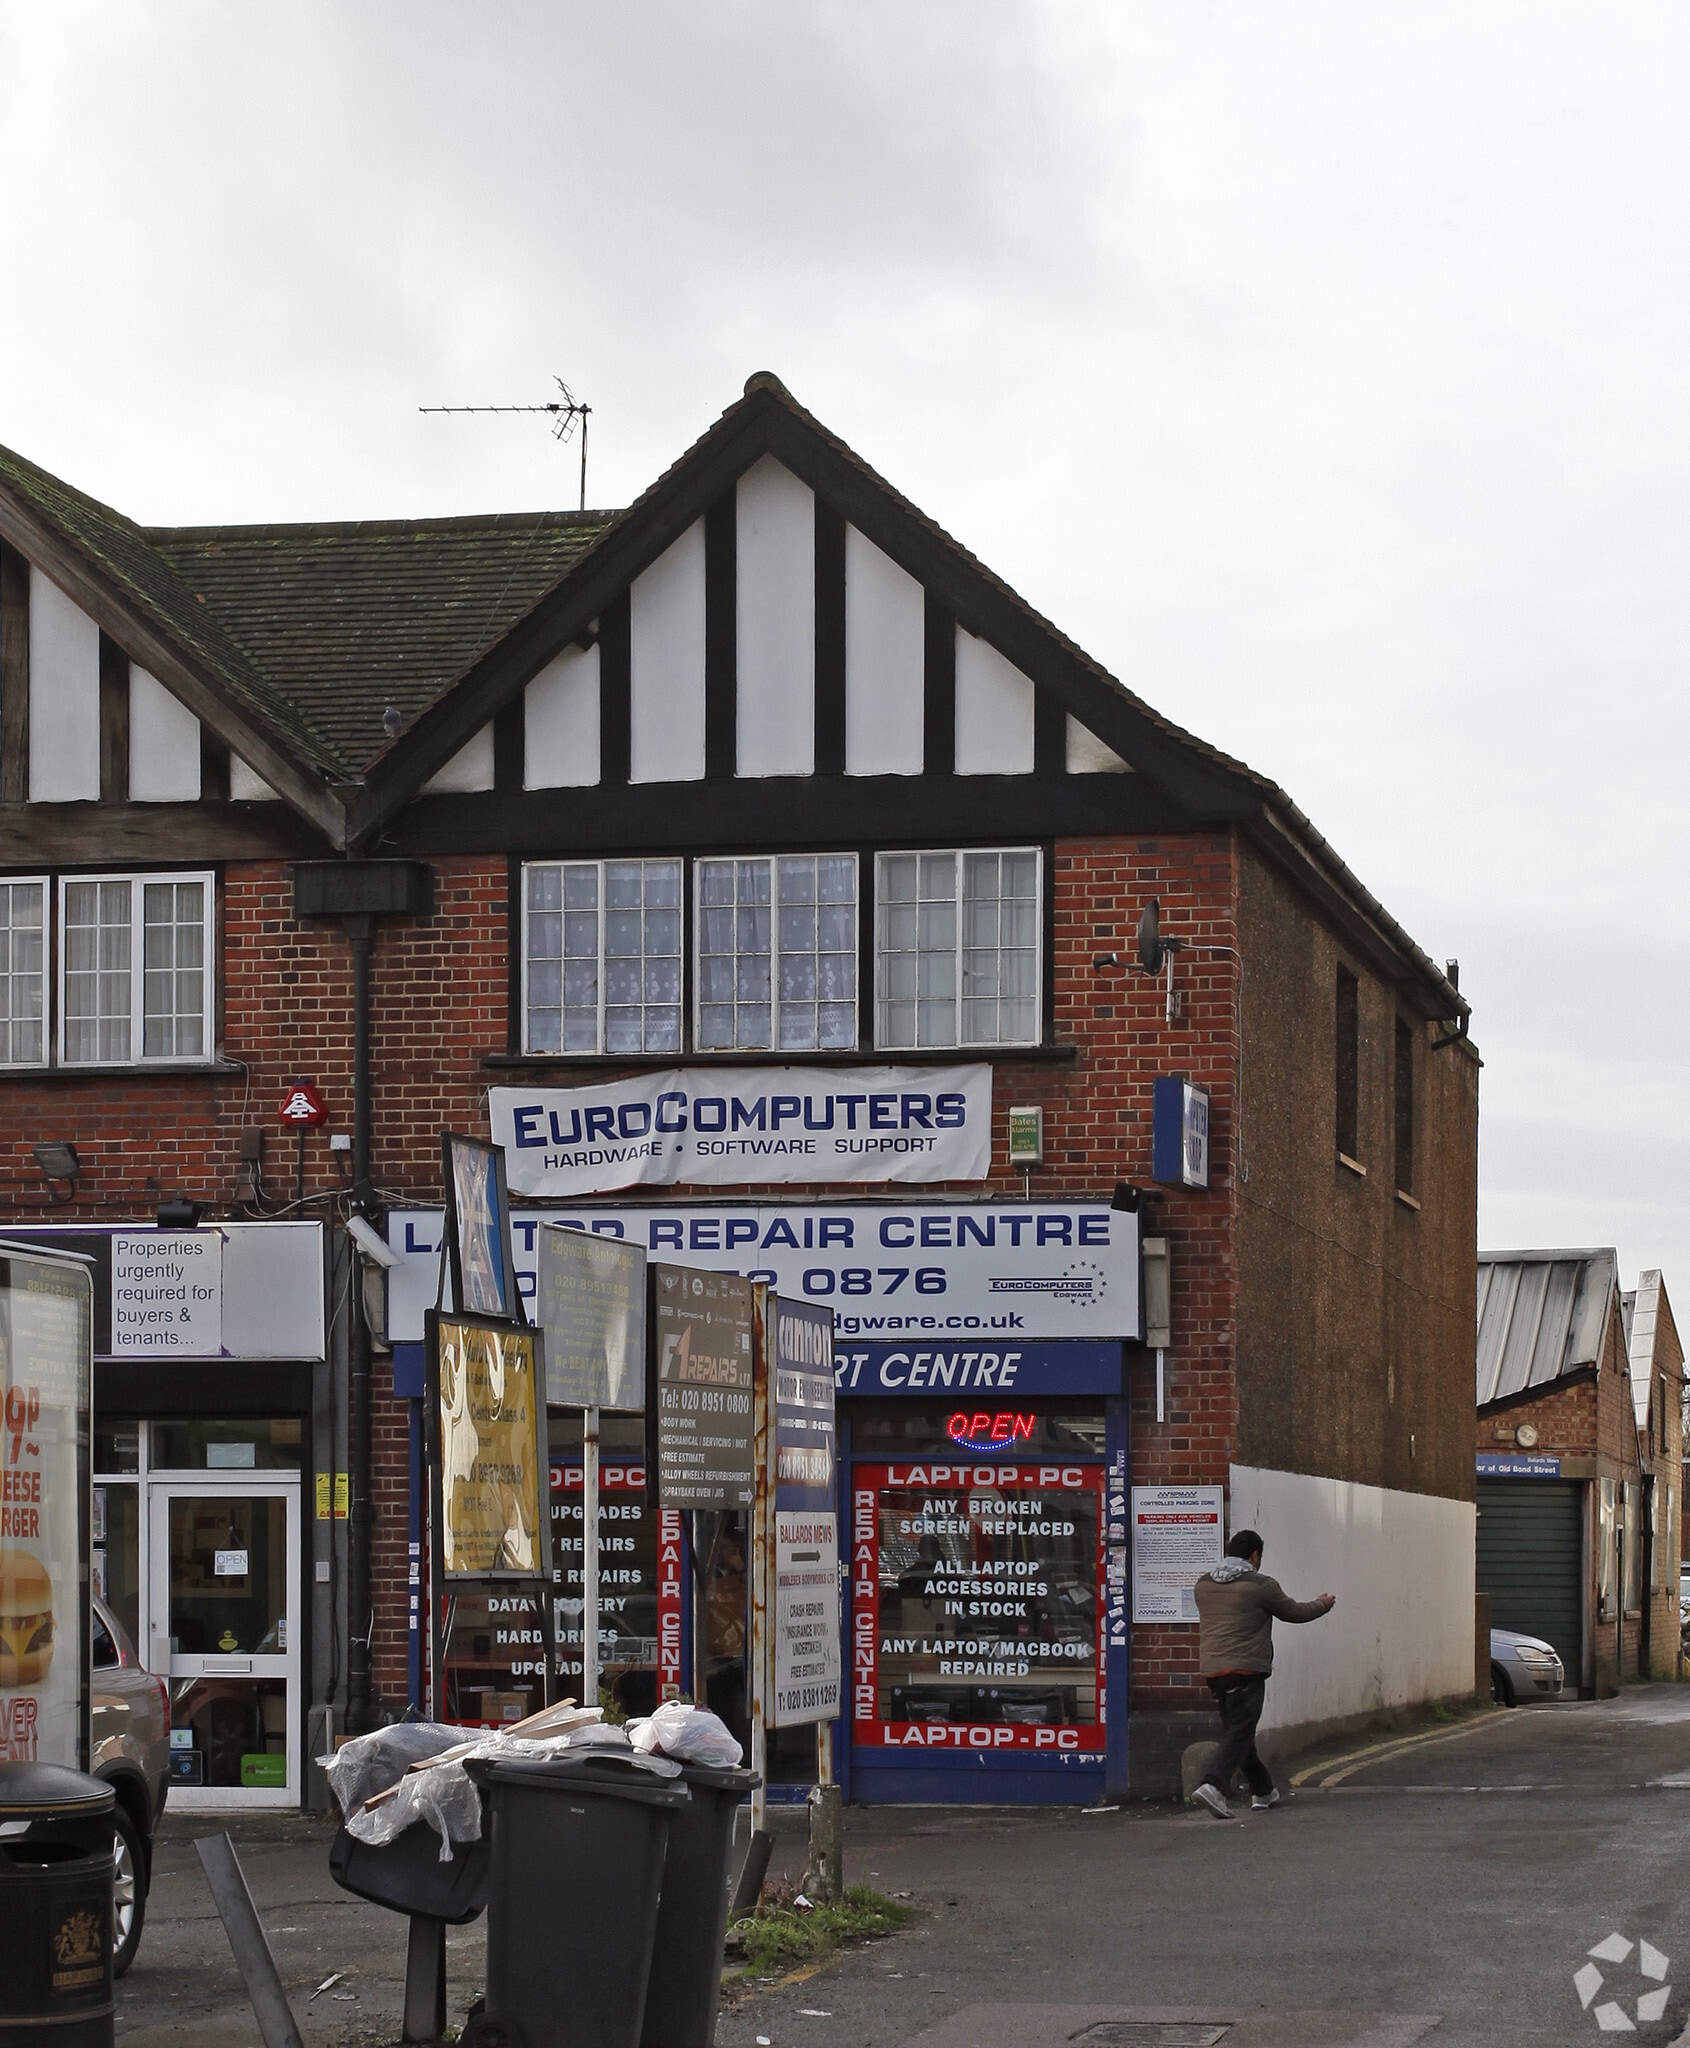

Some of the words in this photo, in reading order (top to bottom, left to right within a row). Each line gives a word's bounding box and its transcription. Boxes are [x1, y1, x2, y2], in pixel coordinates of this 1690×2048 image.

[544, 1141, 662, 1169] HARDWARE
[696, 1138, 816, 1156] SOFTWARE
[834, 1136, 937, 1154] SUPPORT
[649, 1217, 854, 1251] REPAIR
[879, 1214, 1110, 1249] CENTRE
[116, 1239, 204, 1258] Properties
[551, 1236, 592, 1261] Edgware
[116, 1262, 184, 1282] urgently
[802, 1267, 948, 1296] 0876
[116, 1284, 186, 1304] required
[190, 1284, 214, 1301] for
[555, 1274, 576, 1289] 020
[580, 1278, 629, 1298] 89513488
[116, 1307, 174, 1326] buyers
[178, 1307, 192, 1322] &
[688, 1354, 738, 1385] REPAIRS
[879, 1353, 1021, 1388] CENTRE
[661, 1388, 679, 1409] Tel:
[681, 1390, 699, 1411] 020
[702, 1392, 725, 1413] 8951
[727, 1395, 750, 1414] 0800
[947, 1412, 1036, 1440] OPEN
[1488, 1464, 1496, 1472] of
[1498, 1464, 1511, 1473] Old
[1513, 1465, 1532, 1473] Bond
[1534, 1466, 1557, 1475] Street
[551, 1505, 642, 1520] UPGADES
[922, 1500, 957, 1514] ANY
[969, 1501, 1042, 1515] BROKEN
[813, 1524, 833, 1544] MEWS
[900, 1521, 971, 1535] SCREEN
[982, 1521, 1075, 1536] REPLACED
[561, 1537, 636, 1552] REAIRS
[855, 1490, 874, 1598] REPAIR
[216, 1554, 247, 1564] OPEN
[934, 1561, 965, 1575] ALL
[971, 1561, 1040, 1576] LAPTOP
[924, 1581, 1048, 1597] ACCESSORIES
[488, 1598, 530, 1612] DATA
[945, 1602, 963, 1616] IN
[968, 1602, 1027, 1617] STOCK
[496, 1630, 543, 1644] HARD
[661, 1613, 681, 1704] CENTR
[881, 1640, 917, 1654] ANY
[922, 1640, 1090, 1659] LAPTOP/MACBOOK
[790, 1664, 802, 1678] FREE
[855, 1613, 874, 1720] CENTRE
[939, 1661, 1030, 1677] REPAIRED
[787, 1689, 801, 1711] 020
